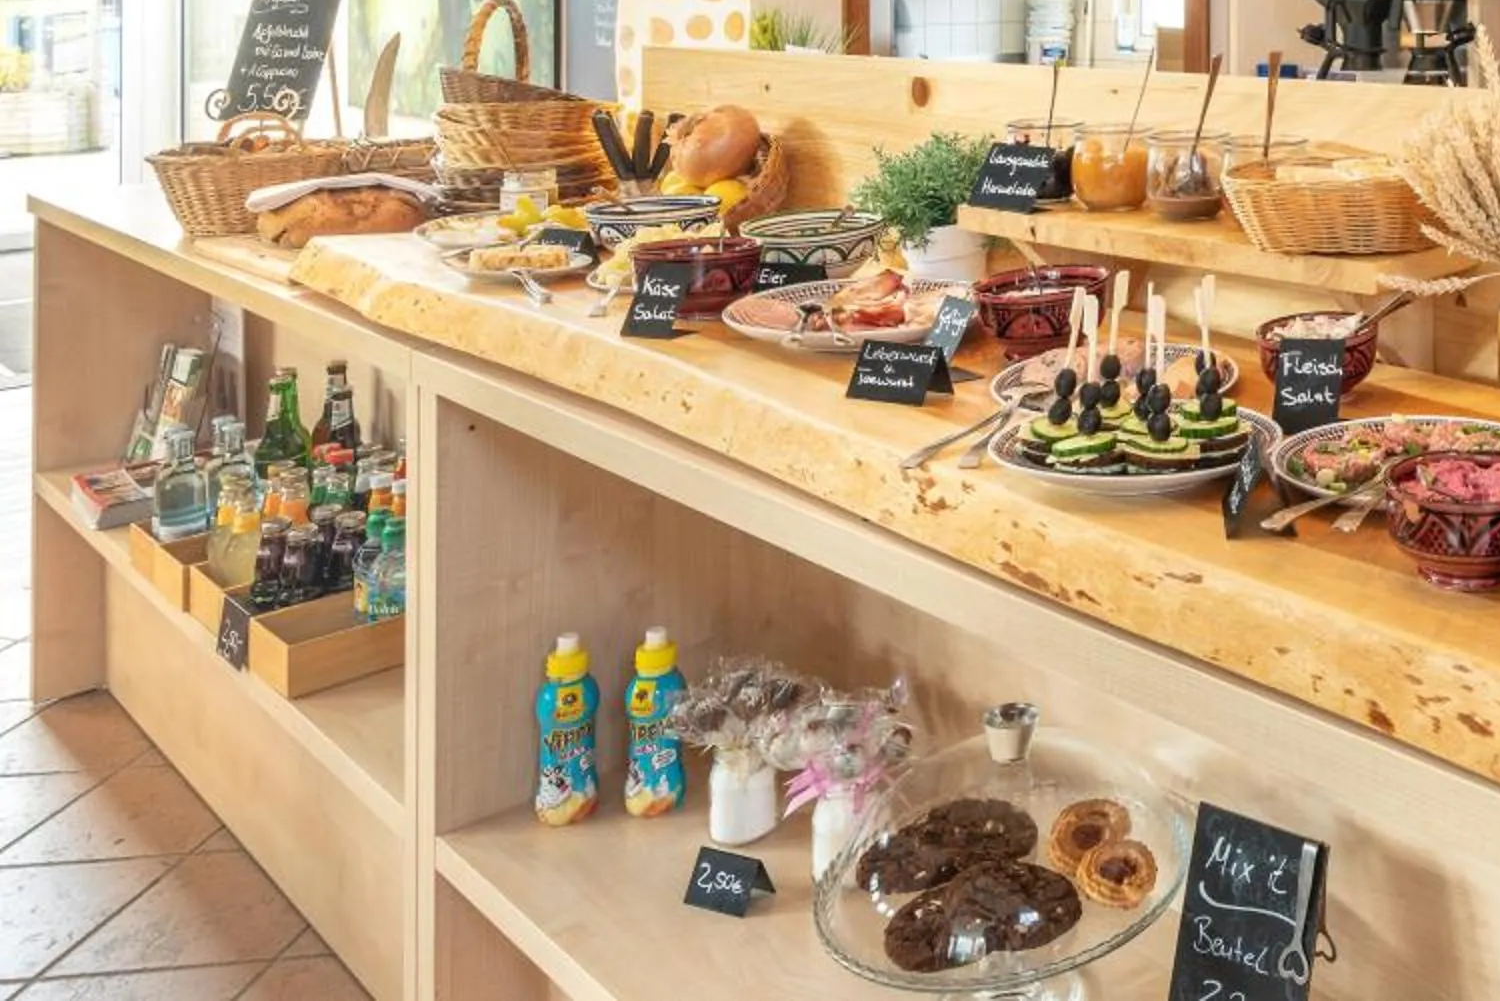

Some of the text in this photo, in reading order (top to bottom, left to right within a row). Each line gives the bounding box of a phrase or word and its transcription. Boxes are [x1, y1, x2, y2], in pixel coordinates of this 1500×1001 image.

[642, 273, 681, 298] Käse
[758, 268, 788, 285] Eier
[633, 303, 676, 321] Salat
[1279, 349, 1343, 377] Fleisch
[1280, 384, 1337, 408] Salat
[1204, 835, 1256, 884] Mix
[1192, 915, 1270, 976] Beutel
